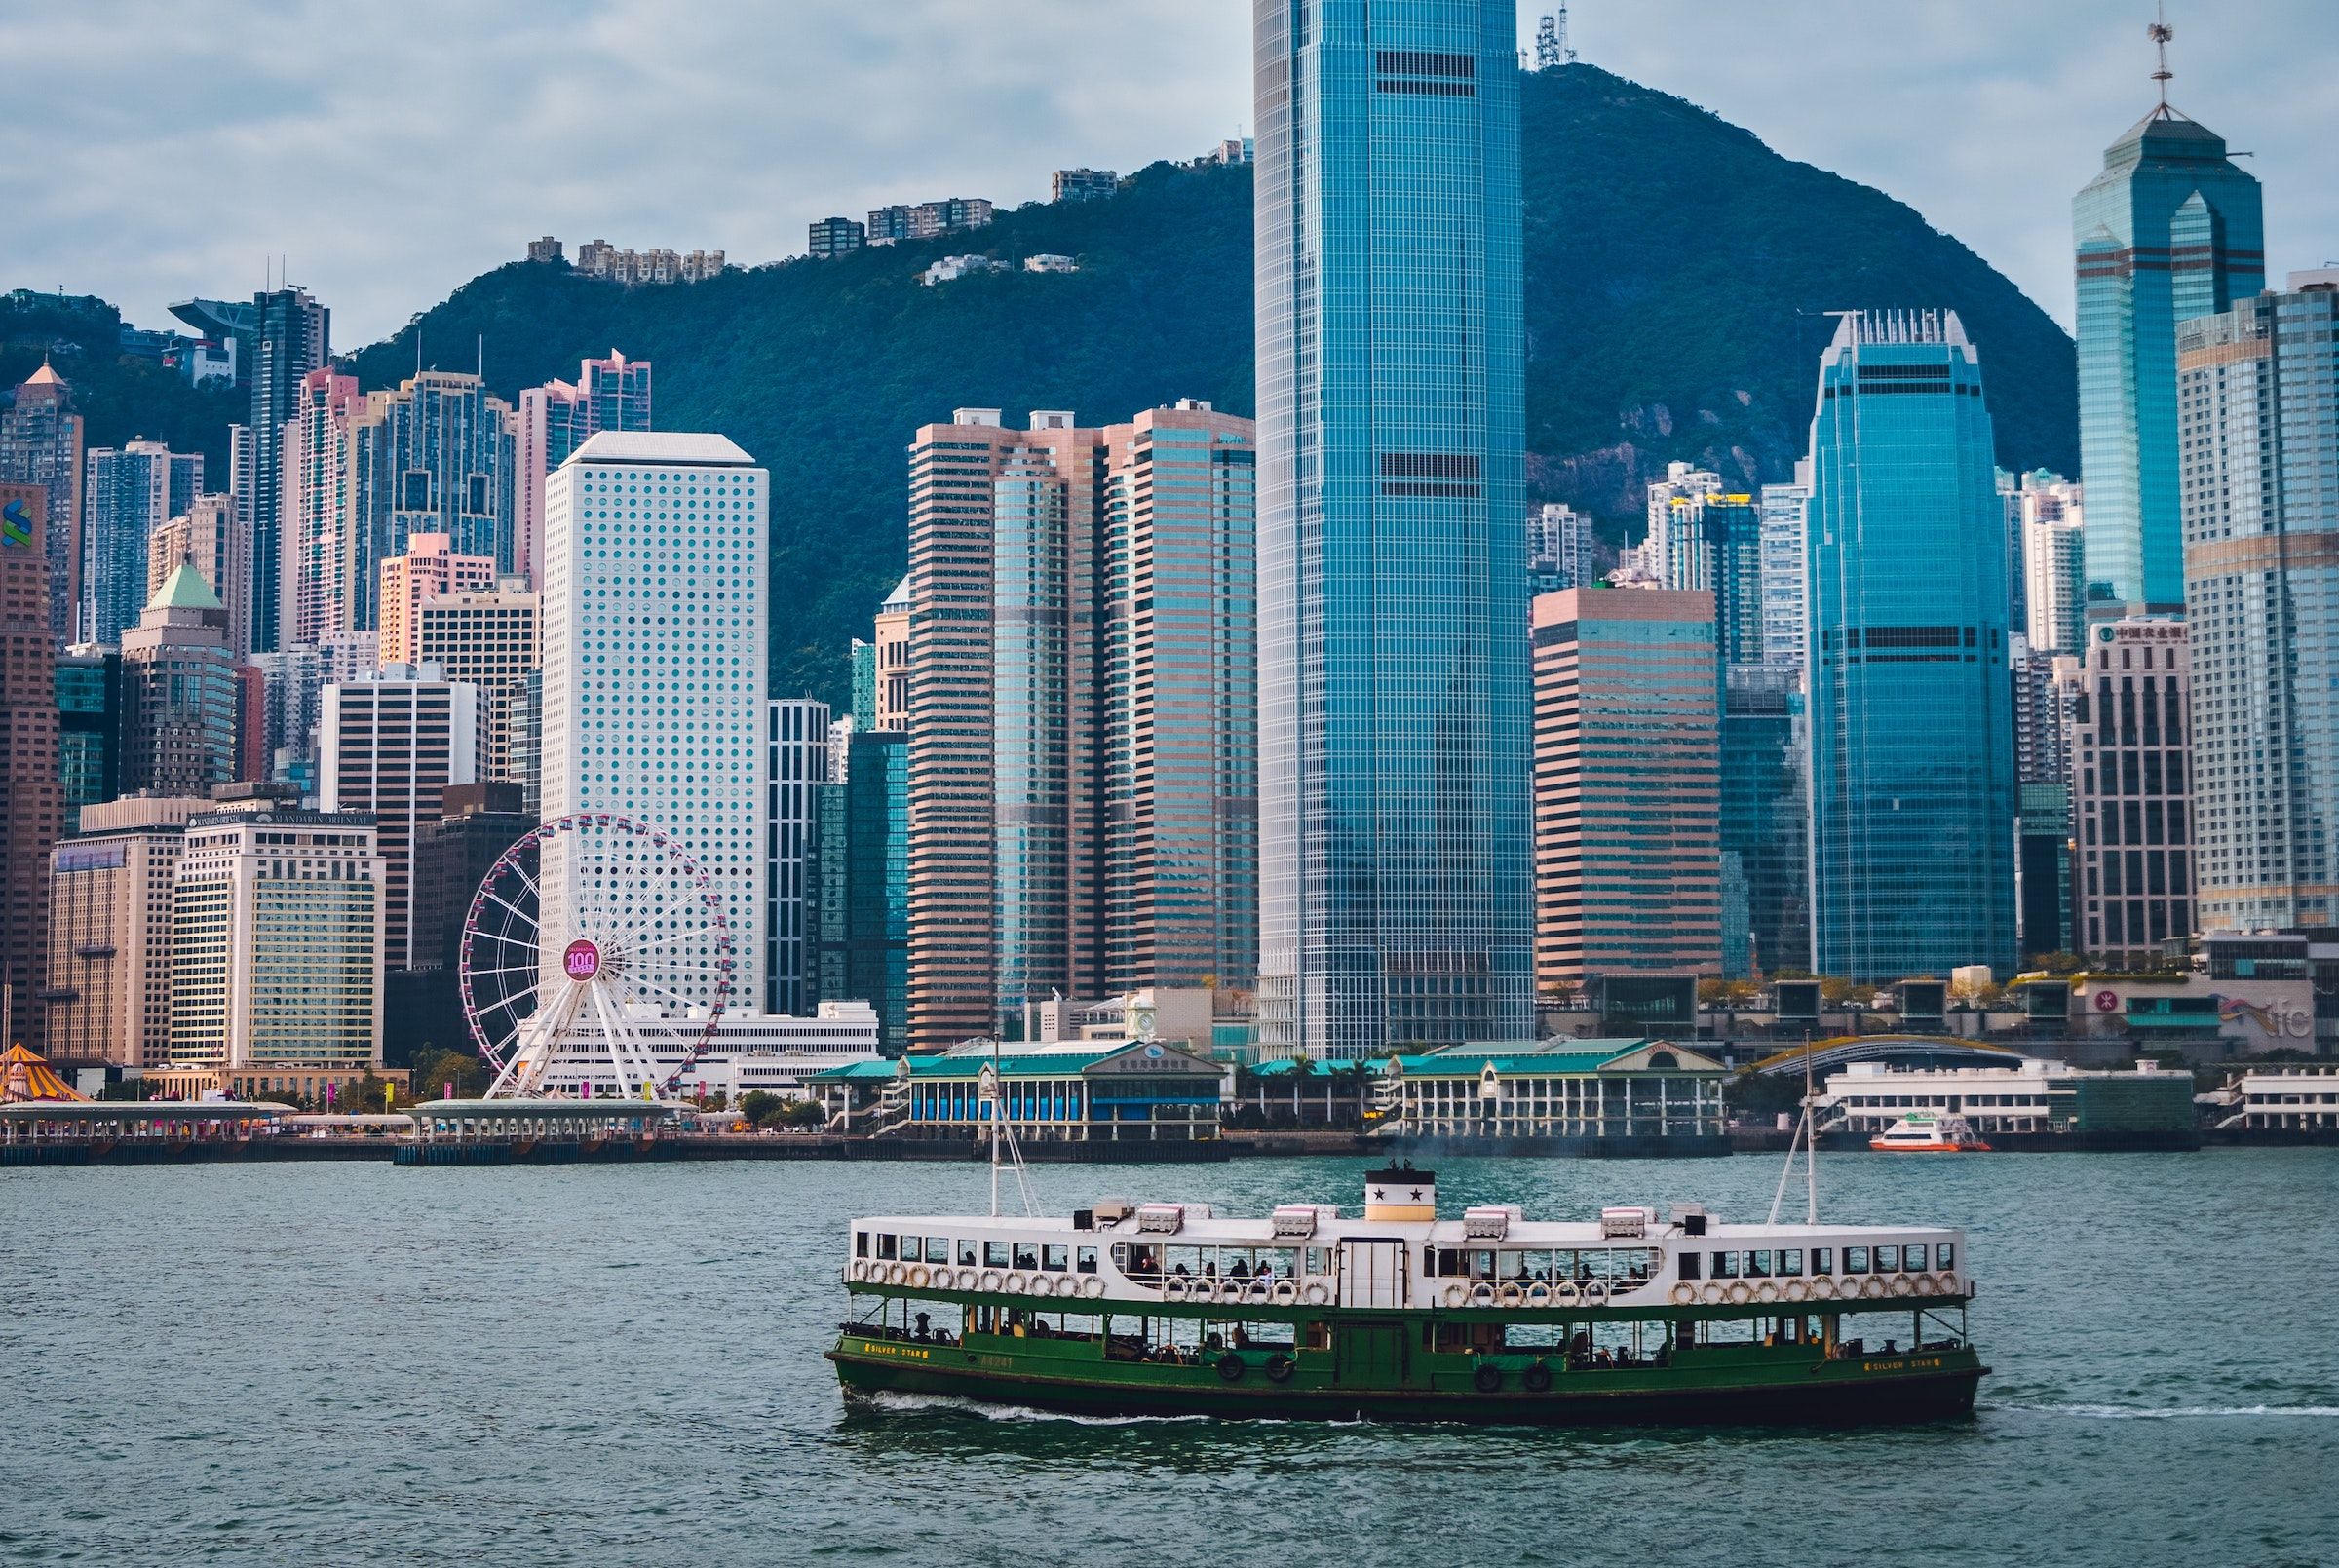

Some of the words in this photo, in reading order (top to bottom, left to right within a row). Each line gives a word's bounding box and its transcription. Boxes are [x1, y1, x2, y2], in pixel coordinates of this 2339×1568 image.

[275, 815, 323, 823] MANDARIN
[325, 816, 366, 824] ORIENTAL
[568, 952, 594, 967] 100
[871, 1345, 896, 1355] SILVER
[1872, 1361, 1903, 1370] SILVER
